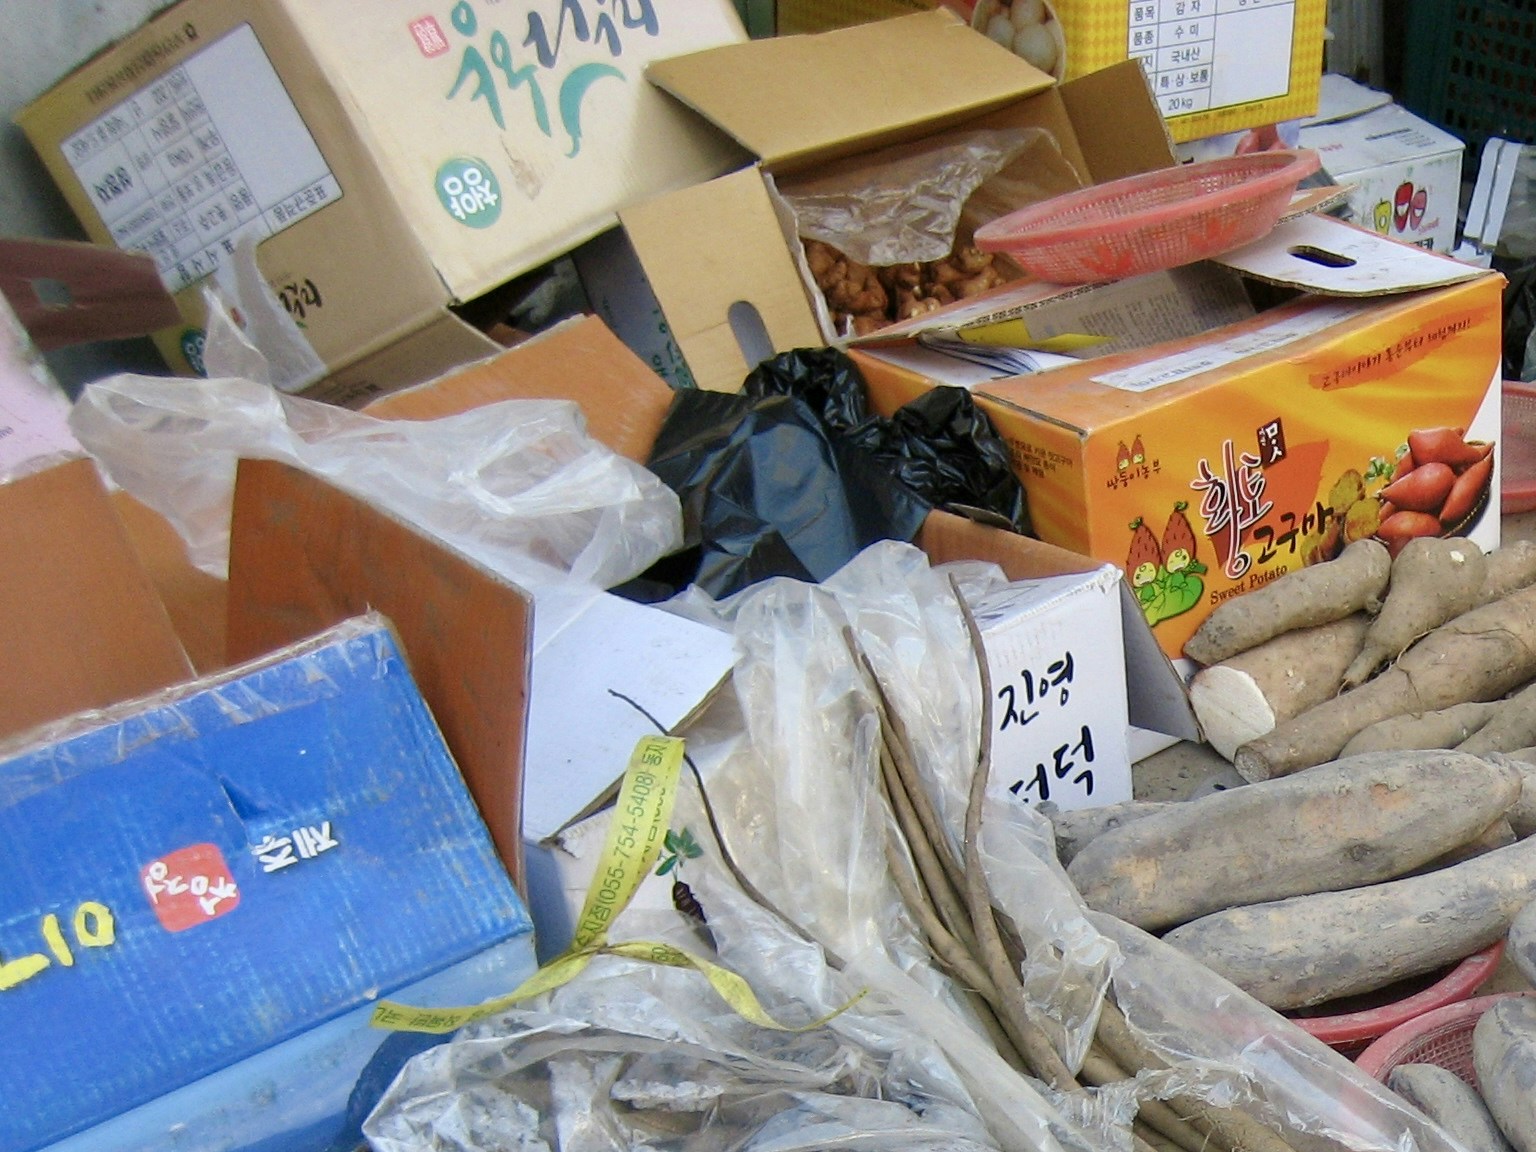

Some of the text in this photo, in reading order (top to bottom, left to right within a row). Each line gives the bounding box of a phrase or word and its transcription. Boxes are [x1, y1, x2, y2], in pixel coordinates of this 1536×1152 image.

[1135, 4, 1154, 21] 품목
[1133, 31, 1153, 45] 품종
[1171, 48, 1200, 62] 국내산
[271, 182, 329, 223] 표준규격품
[442, 170, 500, 220] 청양
[1253, 502, 1333, 564] 고구마
[1210, 565, 1287, 605] Sweet Potato
[998, 651, 1074, 730] 진영
[1009, 725, 1094, 803] 더덕
[251, 821, 339, 874] 제주
